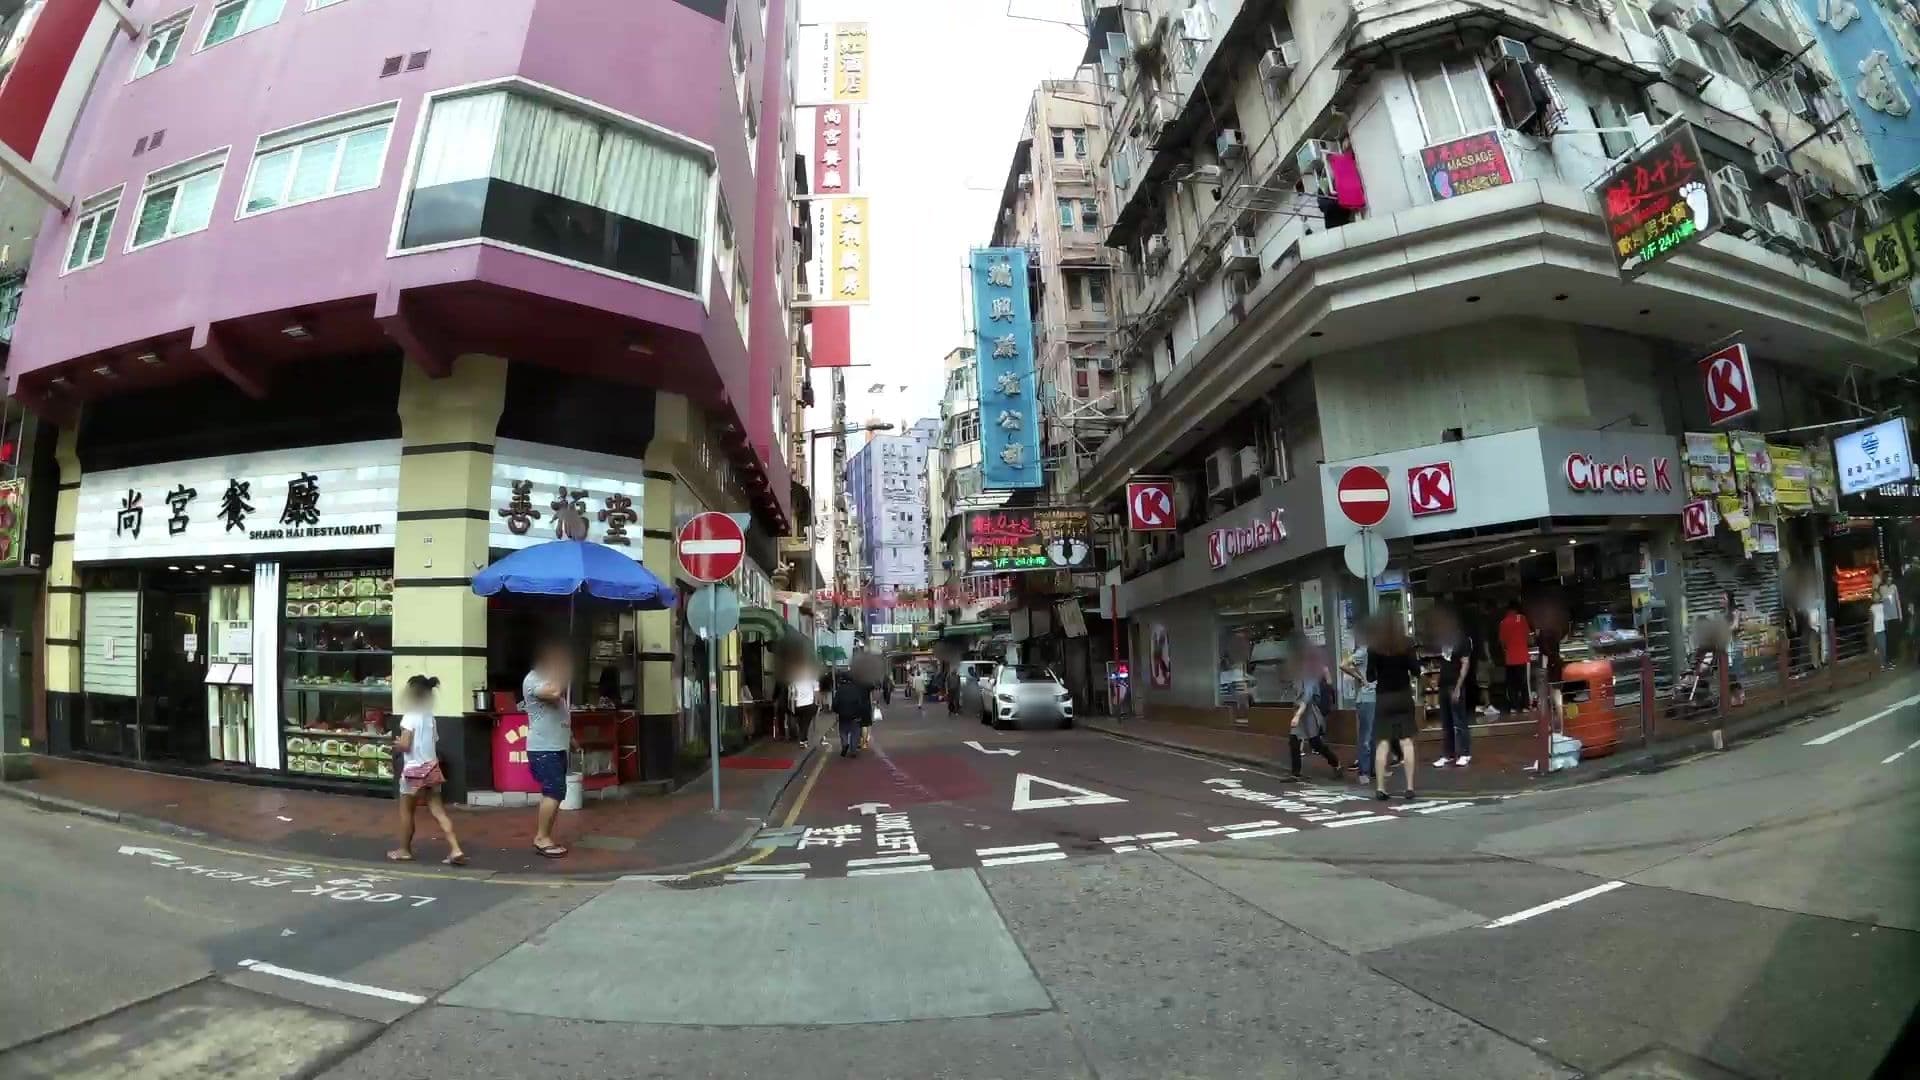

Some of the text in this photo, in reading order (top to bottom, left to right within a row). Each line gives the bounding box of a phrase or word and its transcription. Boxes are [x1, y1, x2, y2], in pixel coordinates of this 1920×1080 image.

[1448, 150, 1496, 170] MASSAGE
[1412, 467, 1451, 509] K
[1566, 452, 1673, 494] Circle K
[116, 472, 320, 540] 尚宮餐廳
[1135, 487, 1170, 525] K
[286, 527, 304, 538] HAI
[306, 524, 382, 537] RESTAURANT
[1226, 519, 1269, 555] Circle
[1271, 507, 1287, 542] K
[150, 859, 438, 907] LOOK RIGHT
